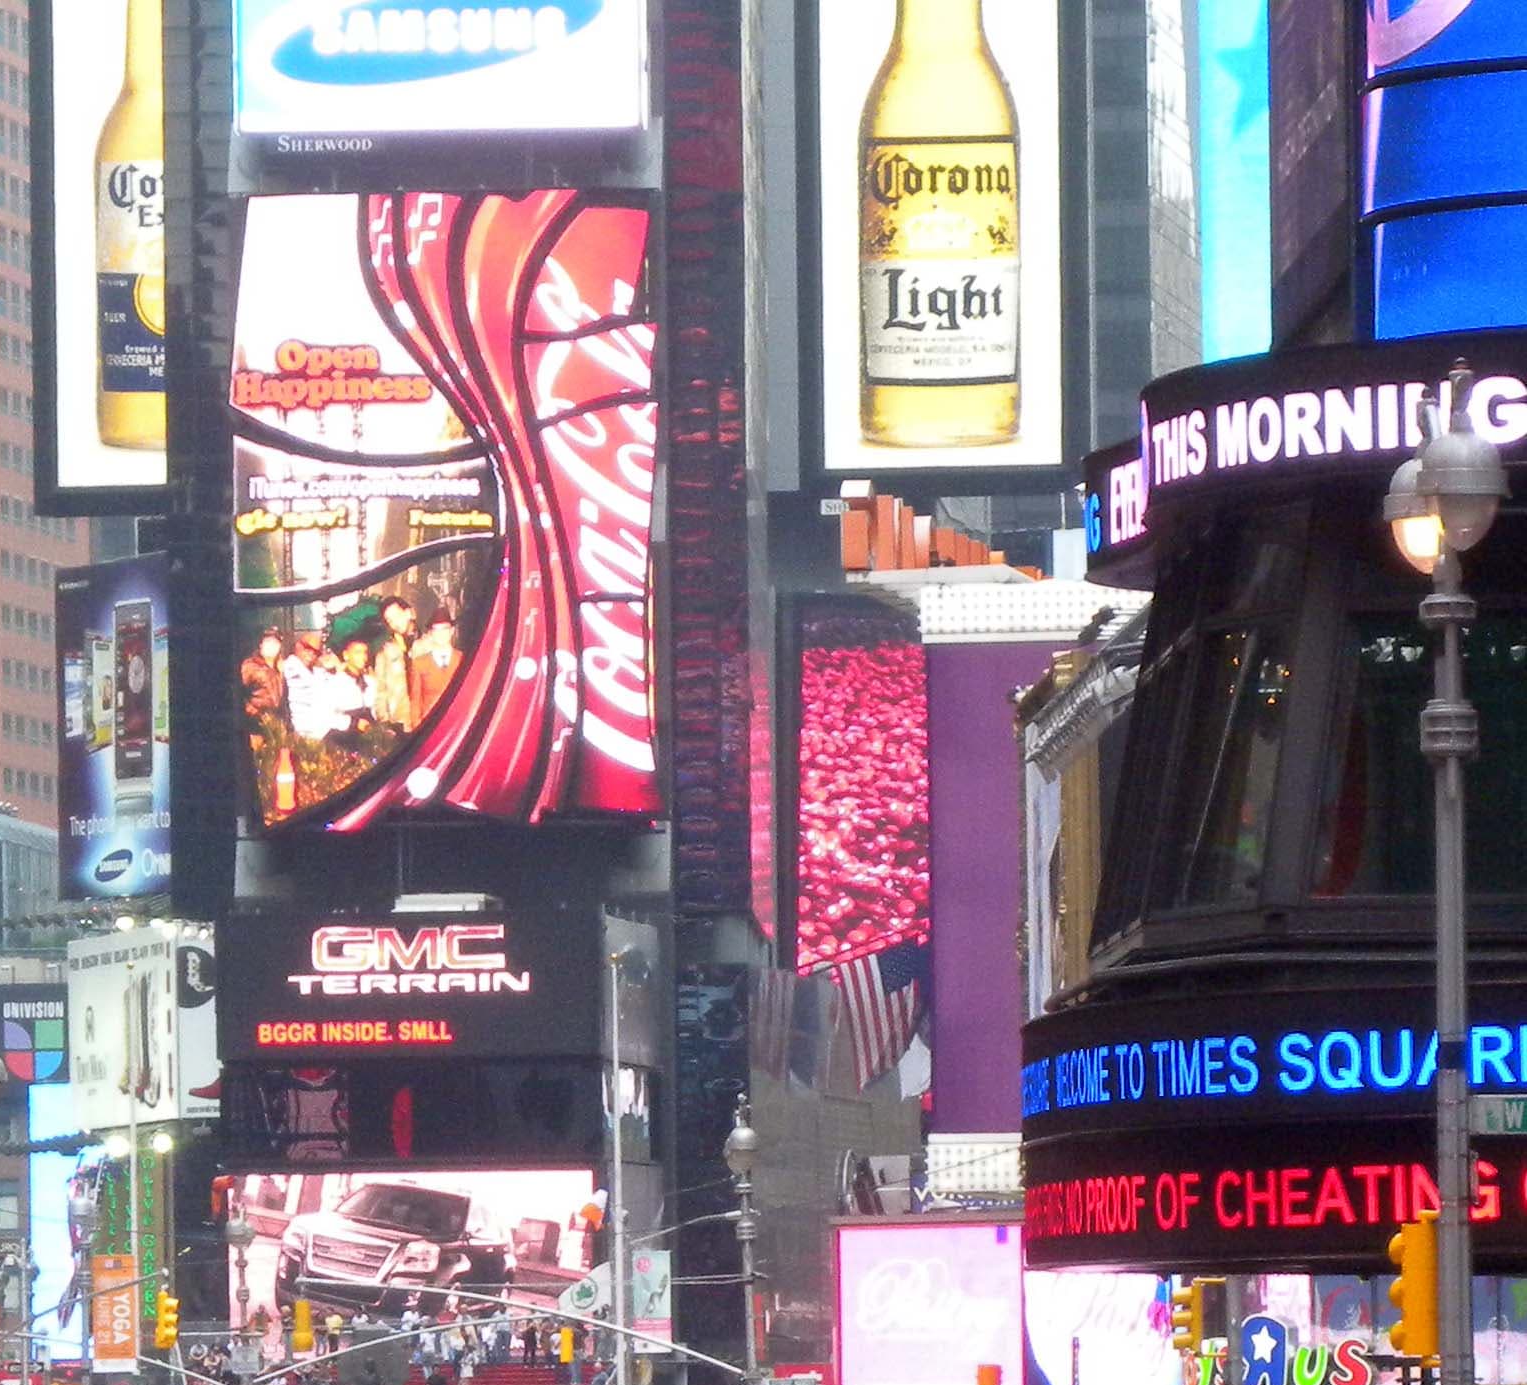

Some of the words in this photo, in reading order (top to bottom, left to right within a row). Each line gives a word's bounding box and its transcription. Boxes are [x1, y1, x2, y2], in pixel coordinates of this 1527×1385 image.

[312, 7, 568, 54] SAMSUNG
[277, 134, 372, 152] SHERWOOD
[108, 164, 165, 212] Co
[874, 153, 1011, 210] Corona
[882, 268, 1003, 331] Light
[276, 339, 380, 374] Open
[233, 369, 432, 409] Happiness
[1152, 408, 1208, 486] THIS
[1216, 375, 1527, 469] MORNING
[311, 924, 506, 972] GMC
[288, 972, 530, 995] TERRAIN
[2, 1001, 65, 1019] UNIVISION
[258, 1022, 316, 1044] BGGR
[322, 1021, 393, 1043] INSIDE.
[399, 1020, 453, 1042] SMLL
[1054, 1043, 1111, 1109] WELCOME
[1114, 1040, 1145, 1100] TO
[1152, 1034, 1260, 1097] TIMES
[1278, 1025, 1527, 1091] SQUAR
[1085, 1174, 1146, 1234] PROOF
[1154, 1171, 1201, 1230] OF
[112, 1293, 131, 1344] YOGA
